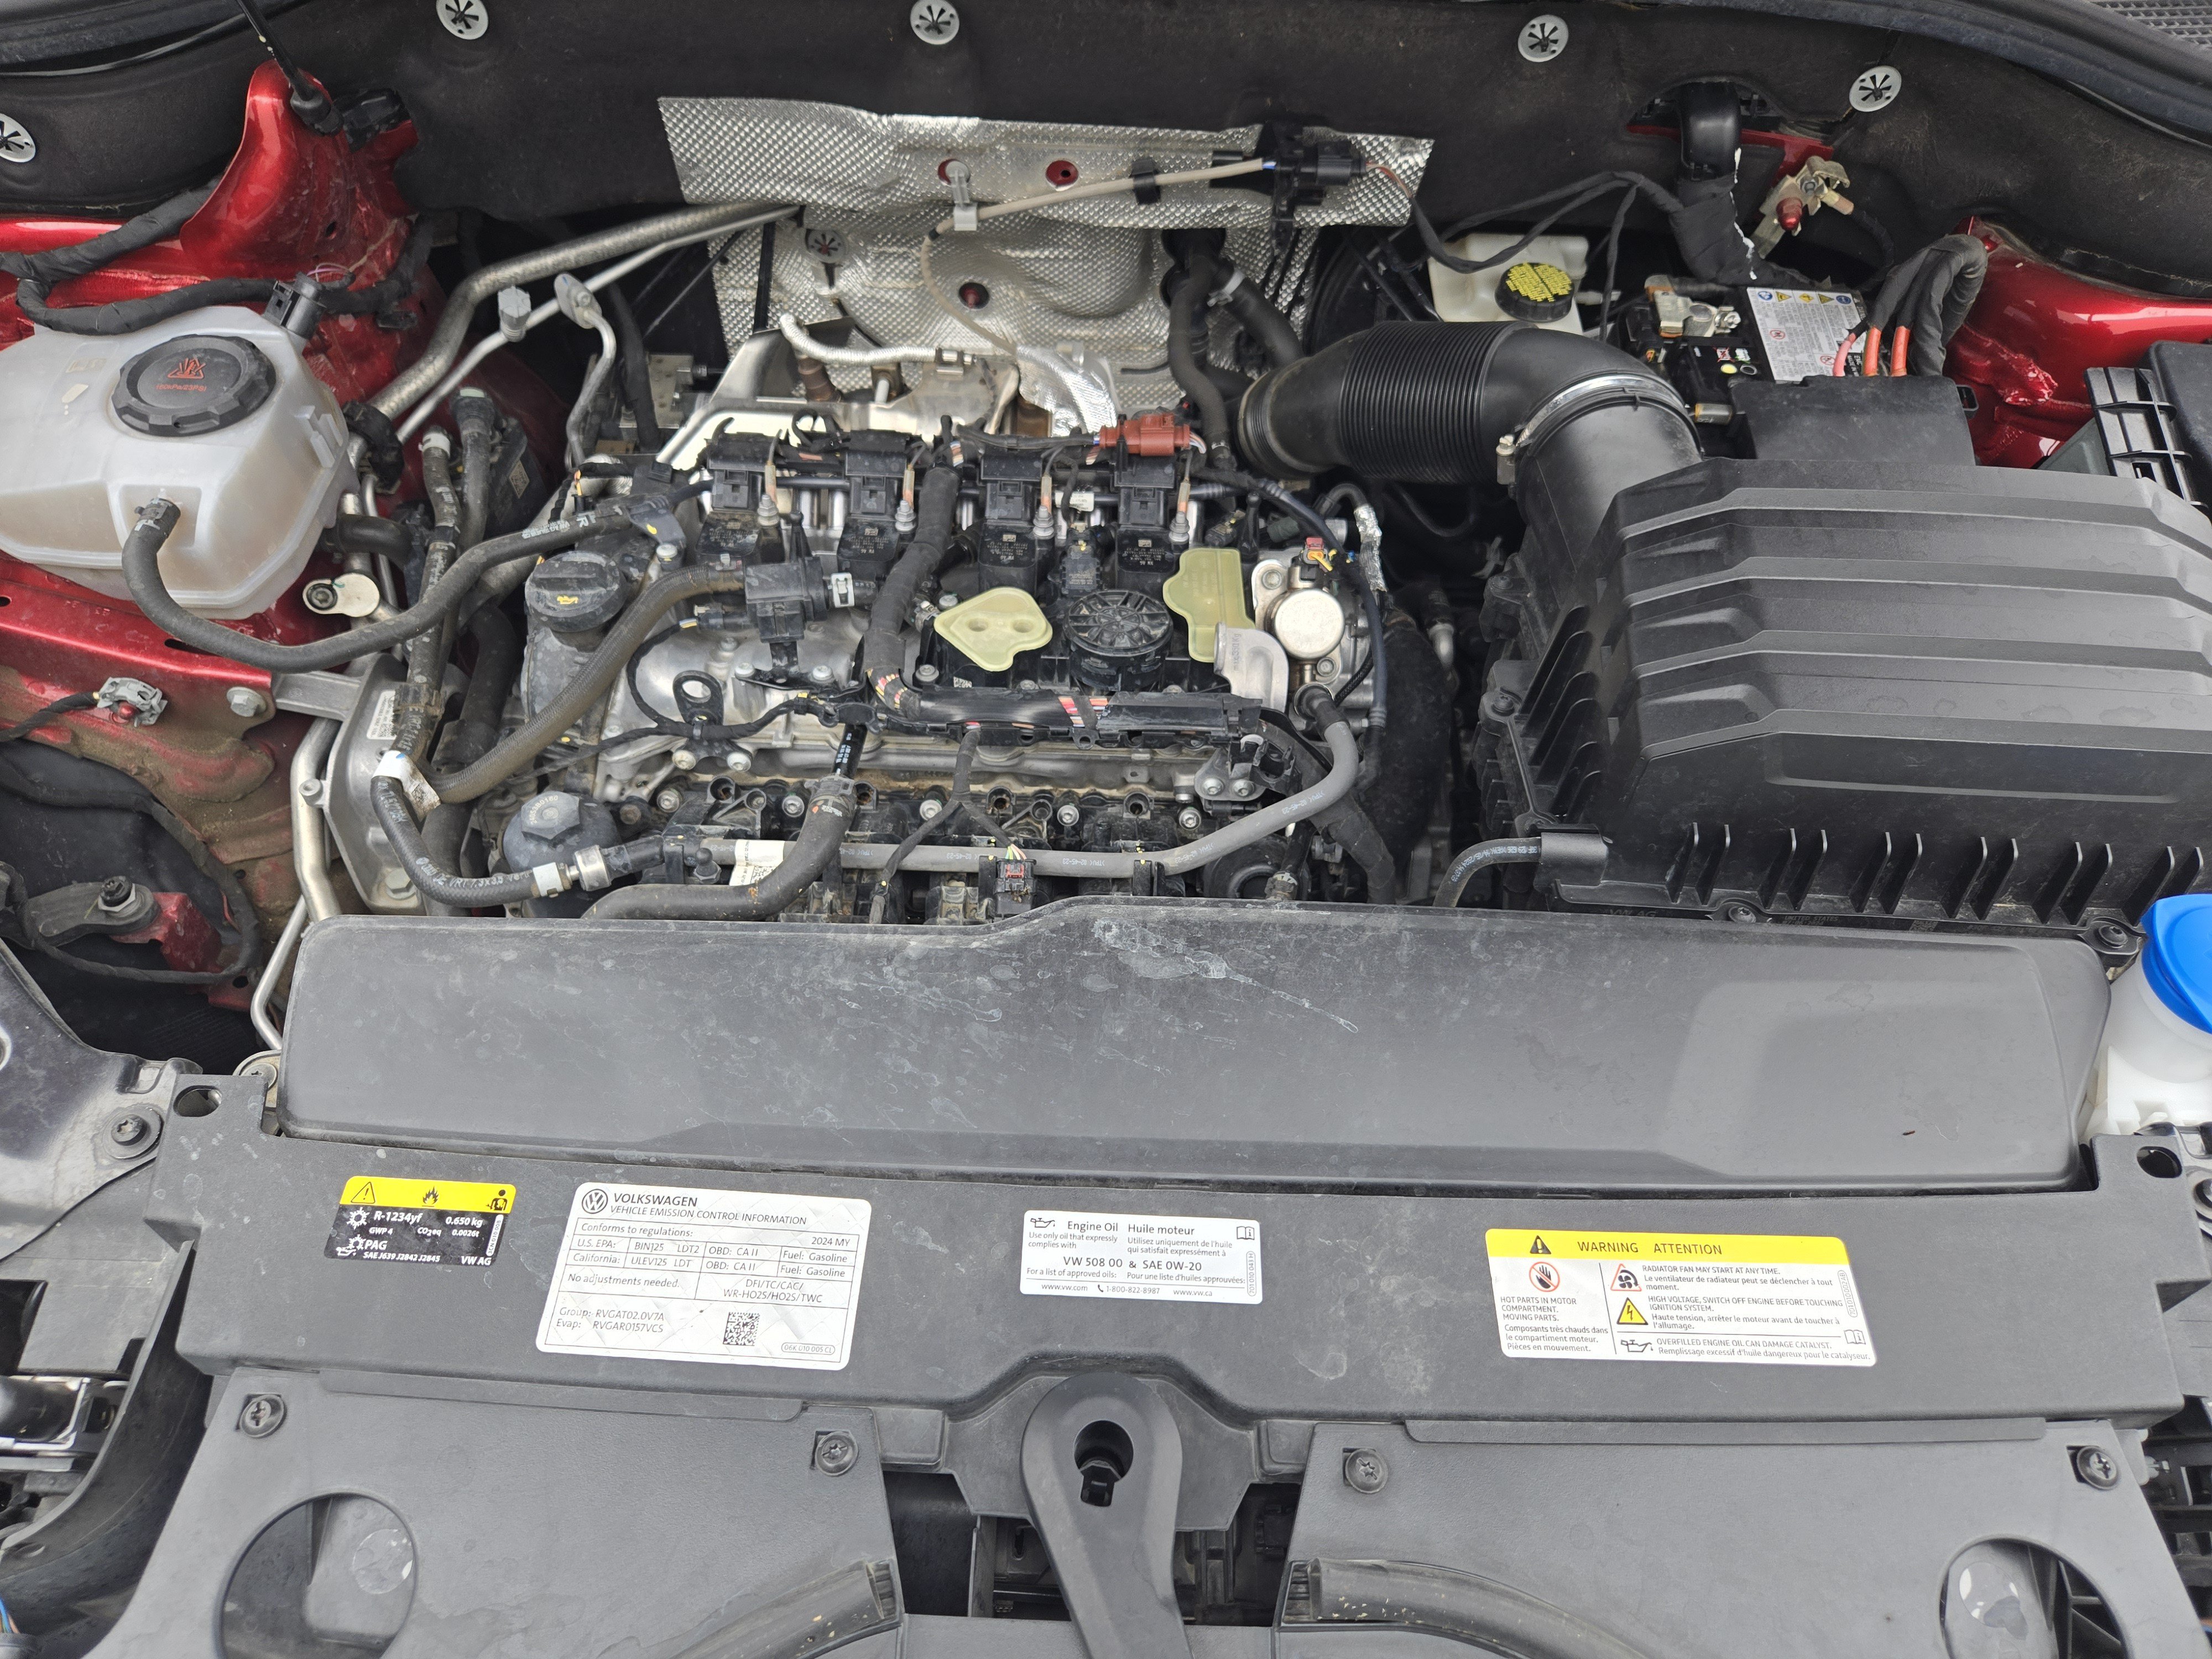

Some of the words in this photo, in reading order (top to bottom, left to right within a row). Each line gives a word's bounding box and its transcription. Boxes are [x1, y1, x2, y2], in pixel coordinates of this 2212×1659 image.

[614, 1192, 698, 1207] VOLKSWAGEN
[373, 1210, 423, 1225] R-1234yf
[611, 1205, 648, 1215] VEHICLE
[649, 1207, 695, 1218] EMISSION
[696, 1210, 739, 1220] CONTROL
[741, 1213, 807, 1225] INFORMATION
[445, 1216, 471, 1225] 0.650
[471, 1217, 483, 1228] kg
[1067, 1220, 1102, 1233] Engine
[1104, 1222, 1118, 1232] Oil
[368, 1227, 388, 1235] GWP
[451, 1229, 479, 1237] 0.0026t
[581, 1222, 625, 1233] Conforms
[627, 1225, 637, 1234] to
[638, 1226, 693, 1237] regulations:
[1128, 1223, 1154, 1233] Huile
[1157, 1225, 1195, 1235] moteur
[577, 1238, 593, 1247] U.S.
[595, 1239, 616, 1248] EPA:
[811, 1236, 833, 1245] 2024
[834, 1238, 851, 1246] MY
[1042, 1232, 1058, 1241] only
[1085, 1234, 1118, 1244] expressly
[1127, 1236, 1154, 1245] Utilisez
[1155, 1238, 1199, 1247] uniquement
[1211, 1240, 1233, 1248] l'huile
[364, 1239, 388, 1250] PAG
[675, 1243, 700, 1254] LDT2
[1027, 1240, 1060, 1249] complies
[1577, 1241, 1639, 1253] WARNING
[1653, 1243, 1722, 1255] ATTENTION
[708, 1246, 732, 1255] OBD:
[736, 1247, 749, 1256] CA
[782, 1250, 804, 1260] Fuel:
[808, 1252, 847, 1262] Gasoline
[1126, 1245, 1139, 1254] qui
[1140, 1246, 1168, 1254] satisfait
[1170, 1248, 1220, 1256] expressément
[395, 1253, 418, 1261] J2842
[418, 1254, 441, 1262] J2845
[461, 1255, 478, 1265] VW
[476, 1256, 492, 1265] AG
[573, 1253, 620, 1264] California:
[630, 1256, 667, 1266] ULEV125
[673, 1258, 692, 1267] LDT
[706, 1260, 729, 1270] OBD:
[733, 1262, 746, 1271] CA
[1063, 1256, 1083, 1266] VW
[1085, 1257, 1105, 1267] 508
[1108, 1258, 1123, 1267] 00
[1128, 1260, 1136, 1269] &
[1142, 1260, 1162, 1270] SAE
[1165, 1260, 1202, 1271] 0W-20
[780, 1265, 802, 1275] Fuel:
[806, 1266, 845, 1277] Gasoline
[1045, 1267, 1056, 1276] list
[1066, 1270, 1100, 1278] approved
[567, 1273, 581, 1282] No
[582, 1273, 641, 1285] adjustments
[643, 1277, 679, 1287] needed.
[1159, 1272, 1174, 1281] liste
[1175, 1273, 1202, 1282] d'huiles
[1202, 1276, 1245, 1284] approuvées:
[1706, 1275, 1740, 1284] radiateur
[1106, 1285, 1160, 1294] 1-800-822-8987
[1516, 1296, 1540, 1304] PARTS
[1667, 1295, 1702, 1304] VOLTAGE,
[1747, 1297, 1775, 1305] ENGINE
[1804, 1298, 1843, 1307] TOUCHING
[559, 1306, 591, 1319] Group:
[1501, 1304, 1558, 1313] COMPARTMENT.
[1683, 1303, 1714, 1312] SYSTEM.
[556, 1318, 581, 1329] Evap:
[1504, 1324, 1549, 1333] Composants
[1549, 1324, 1564, 1333] très
[1564, 1325, 1590, 1333] chauds
[1514, 1334, 1568, 1343] compartiment
[1702, 1338, 1731, 1347] ENGINE
[1794, 1340, 1832, 1349] CATALYST.
[1507, 1342, 1531, 1350] Pièces
